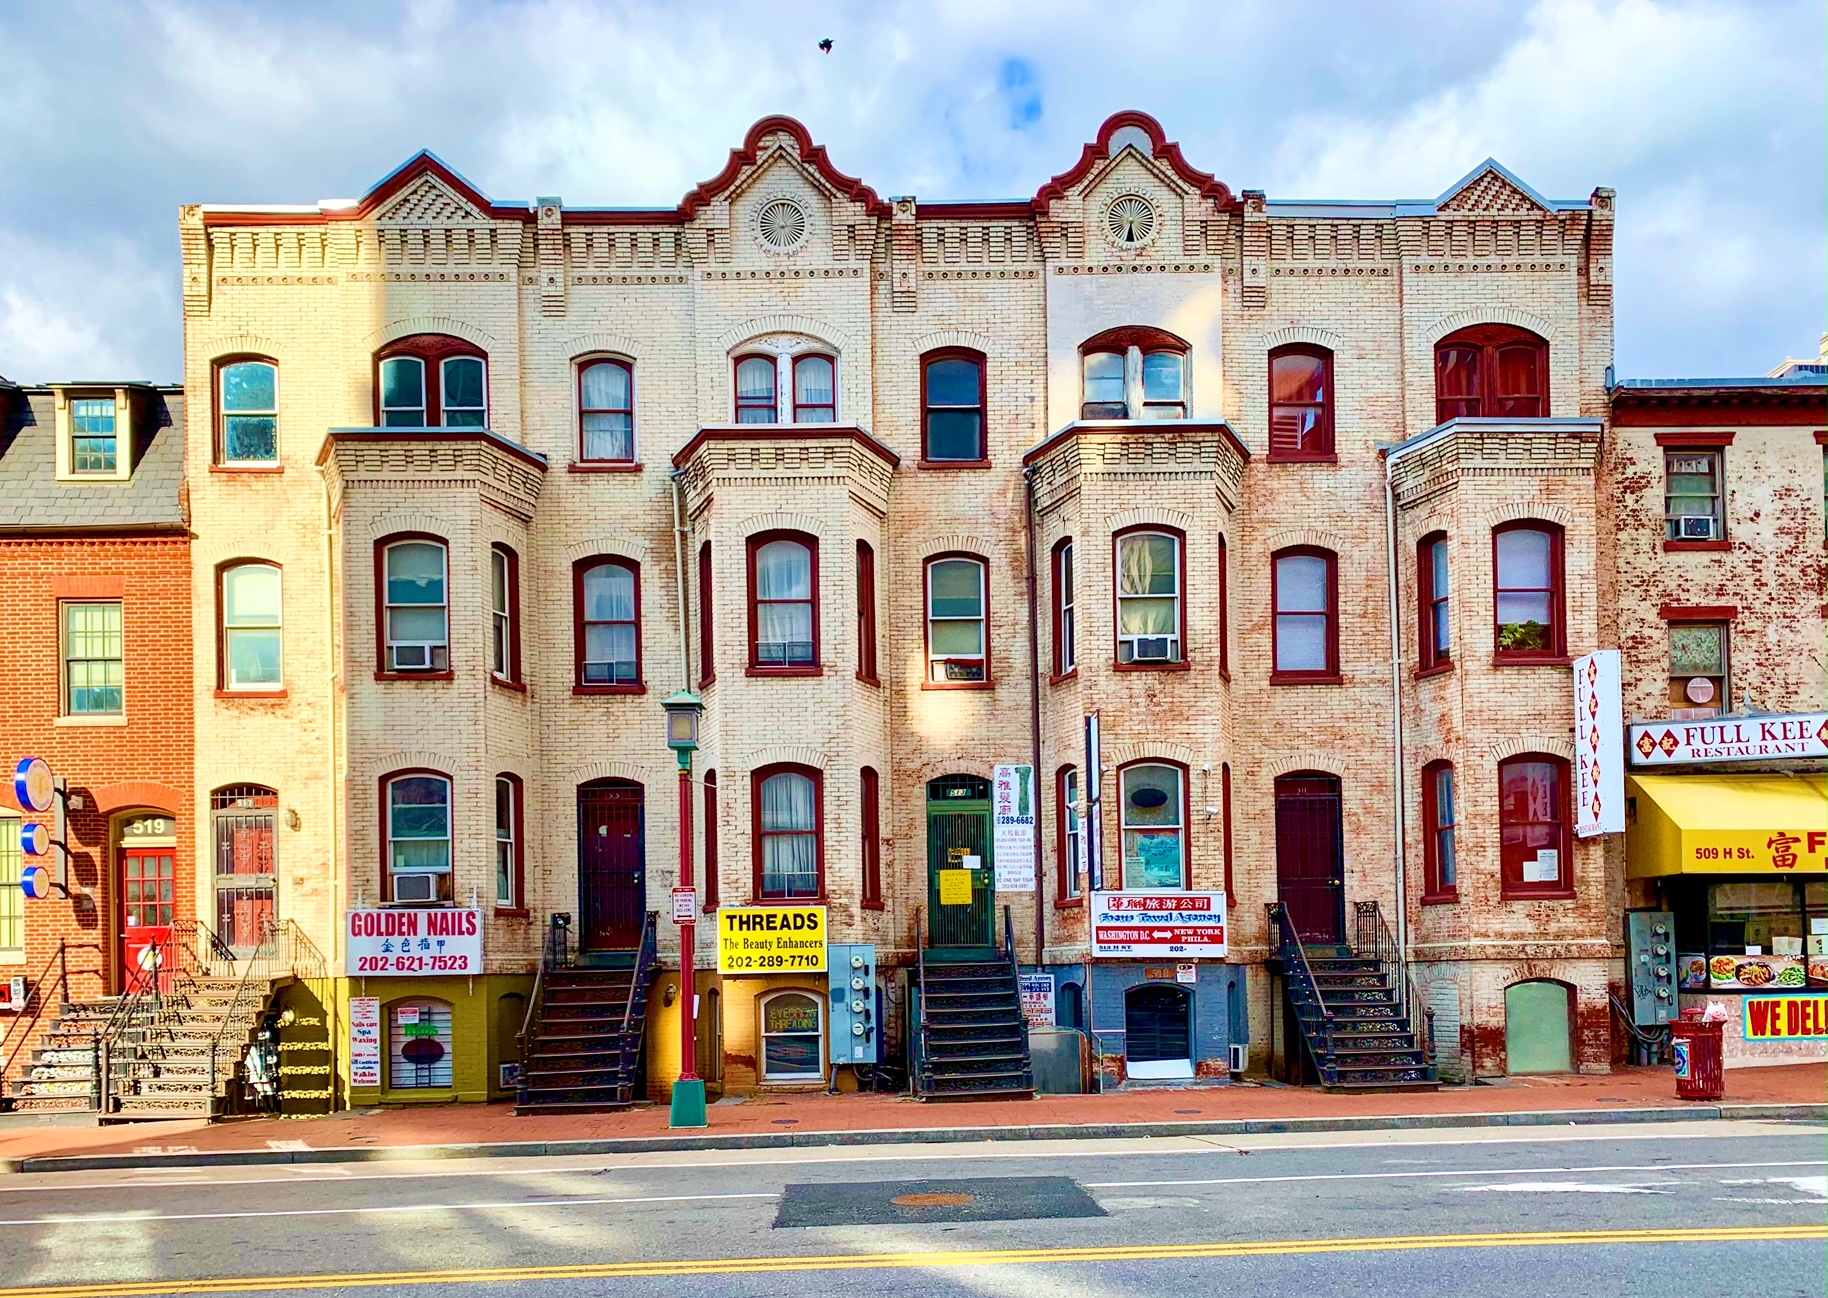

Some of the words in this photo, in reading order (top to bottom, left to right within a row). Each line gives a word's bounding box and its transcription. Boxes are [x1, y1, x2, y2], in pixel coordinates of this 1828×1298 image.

[1684, 724, 1750, 747] FULL
[1759, 720, 1813, 742] KEE
[1690, 742, 1810, 759] RESTAURANT
[133, 819, 165, 835] 519
[1001, 816, 1034, 825] 289-6682
[1695, 847, 1719, 859] 509
[1723, 847, 1732, 859] H
[1737, 847, 1754, 859] St.
[1767, 831, 1801, 869] 富
[351, 912, 418, 937] GOLDEN
[427, 911, 477, 936] NAILS
[725, 913, 818, 931] THREADS
[1136, 912, 1172, 923] Travel
[1174, 912, 1221, 924] Agency
[1098, 930, 1139, 941] WASHINGTON
[1140, 930, 1150, 940] D.C.
[381, 938, 446, 954] 金色指甲
[723, 938, 739, 950] The
[743, 938, 773, 951] Beauty
[776, 937, 823, 949] Enhancers
[358, 955, 468, 972] 202-621-7523
[727, 955, 819, 969] 202-289-7710
[769, 1019, 817, 1029] THREADING
[1748, 1000, 1781, 1036] WE
